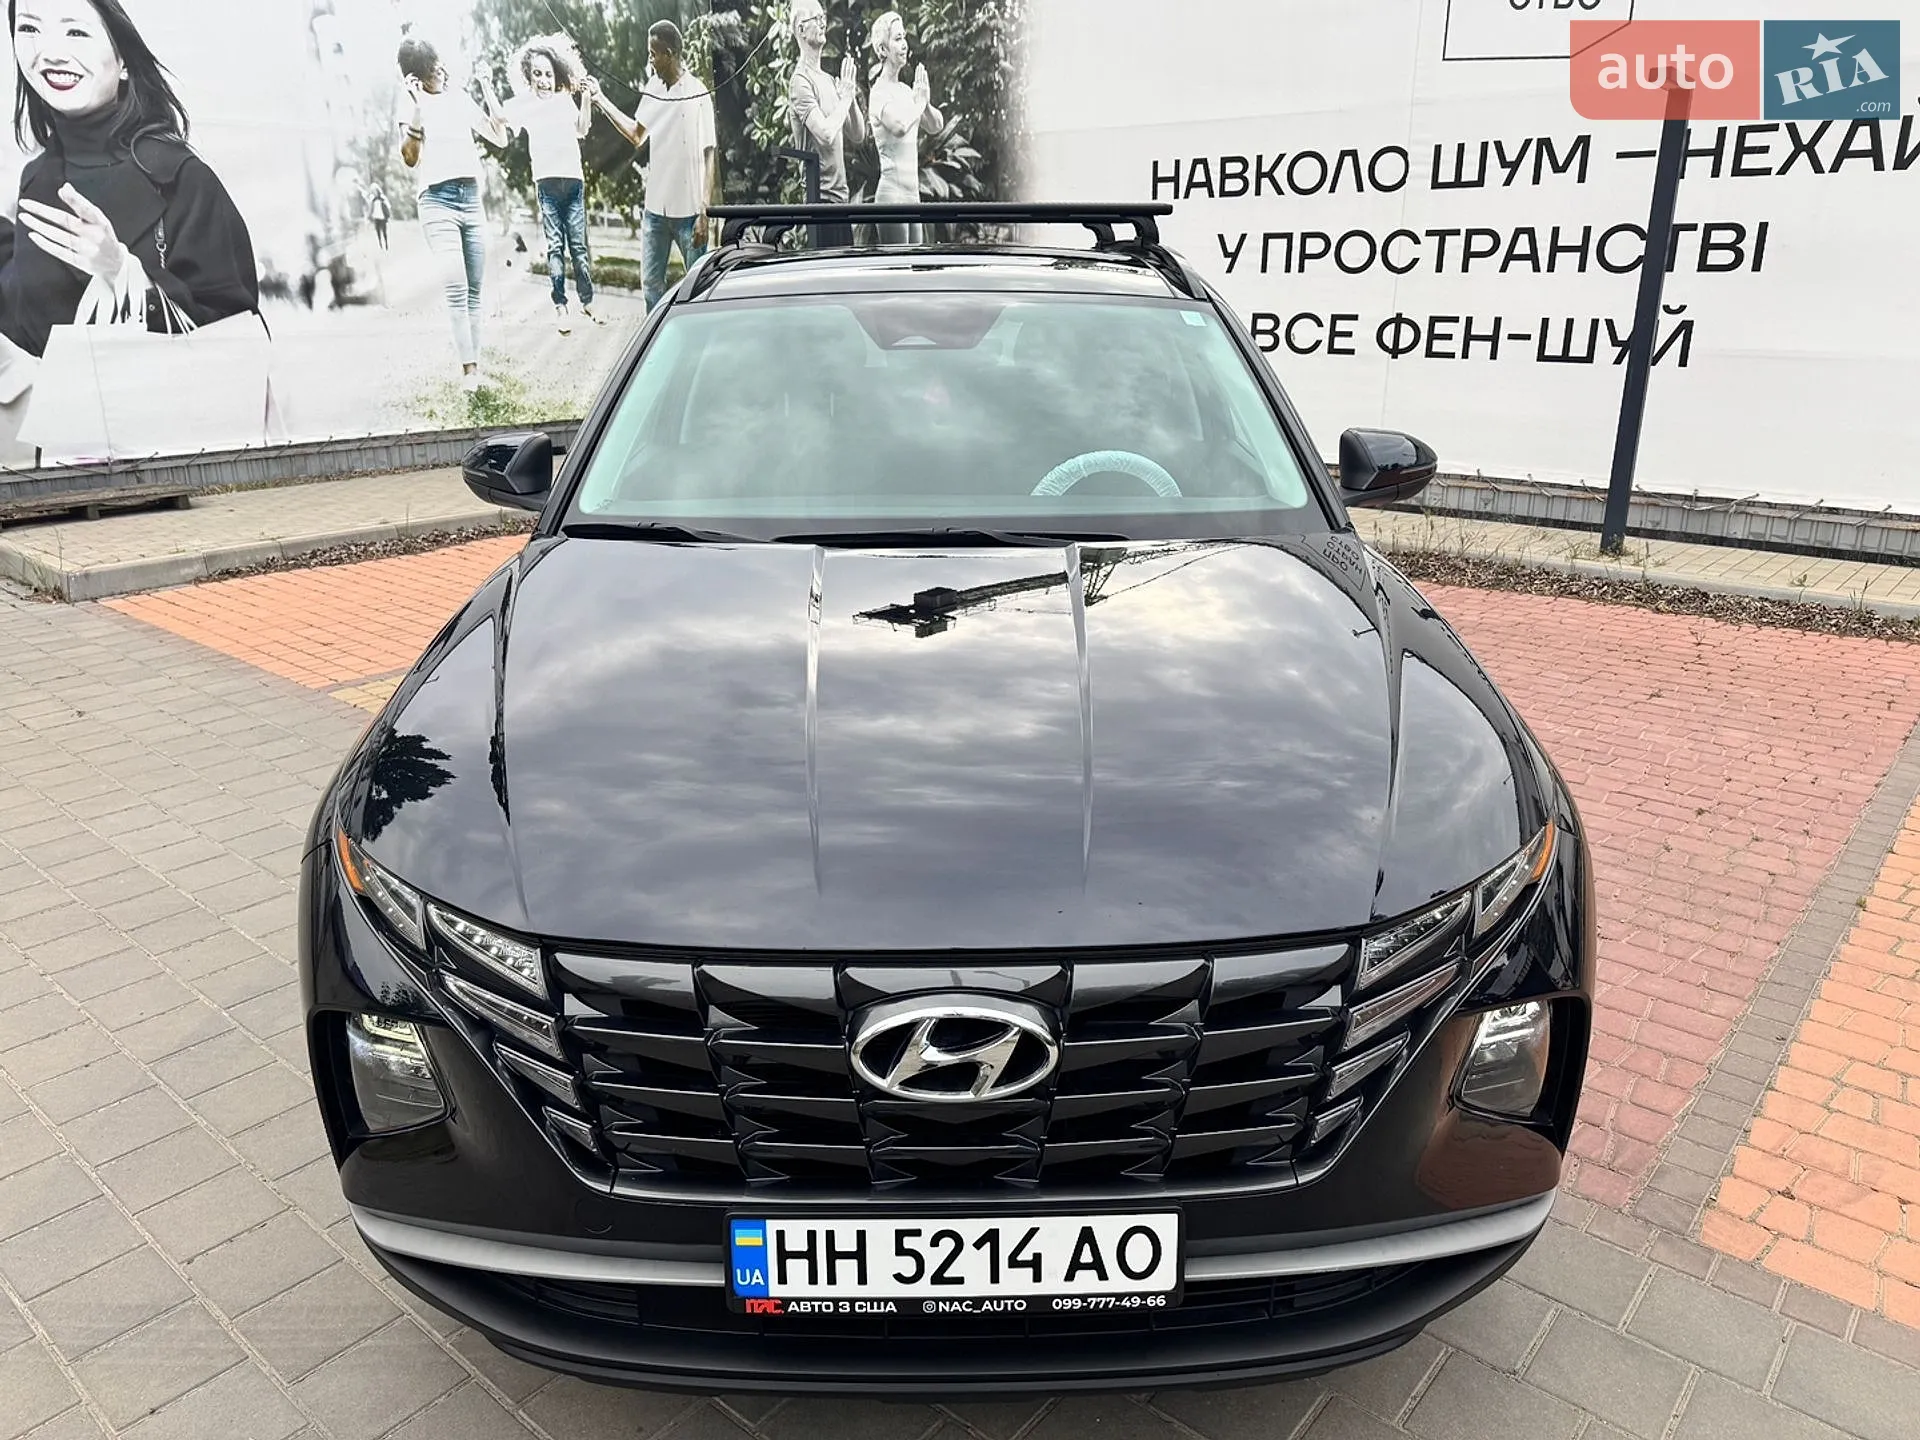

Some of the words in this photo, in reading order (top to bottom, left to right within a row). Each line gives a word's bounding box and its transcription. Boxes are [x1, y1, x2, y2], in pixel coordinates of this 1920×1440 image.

[1151, 145, 1410, 201] НАВКОЛО
[1430, 134, 1592, 190] ШУМ
[1217, 233, 1248, 274] У
[1260, 221, 1769, 275] ПРОСТРАНСТВІ
[1251, 312, 1359, 356] ВСЕ
[1375, 304, 1695, 368] ФЕН-ШУЙ
[775, 1229, 868, 1286] HH
[892, 1226, 1043, 1286] 5214
[1063, 1225, 1162, 1282] AO
[736, 1268, 765, 1286] UA
[787, 1301, 834, 1313] АВТО
[854, 1301, 898, 1313] США
[938, 1299, 1027, 1313] NAC_AUTO
[1051, 1294, 1167, 1310] 099-777-49-66
